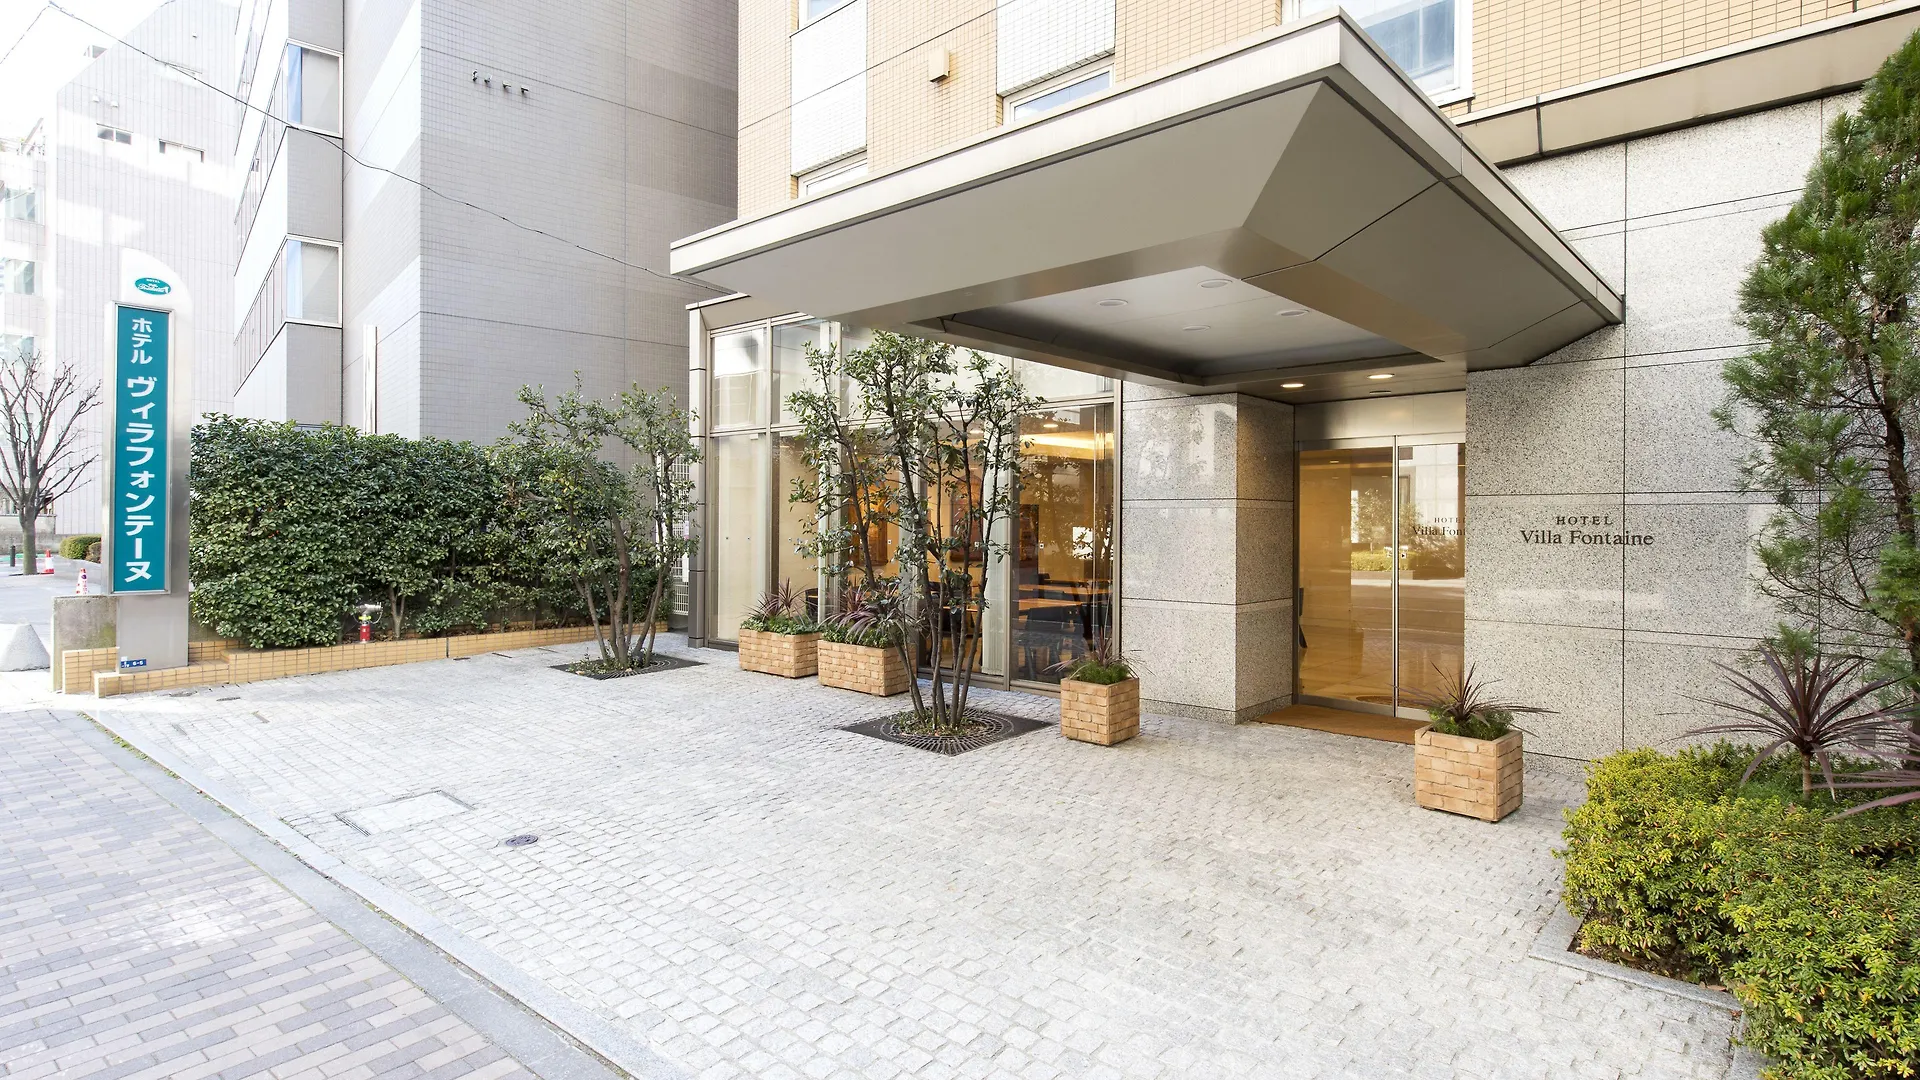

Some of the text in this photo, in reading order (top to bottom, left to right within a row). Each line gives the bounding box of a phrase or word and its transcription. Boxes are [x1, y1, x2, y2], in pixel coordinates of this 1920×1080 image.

[124, 317, 158, 583] ホテル ヴィラフォンテーヌ
[1556, 516, 1614, 526] HOTEL
[1412, 525, 1438, 536] Villa
[1520, 530, 1655, 546] Villa Fontaine
